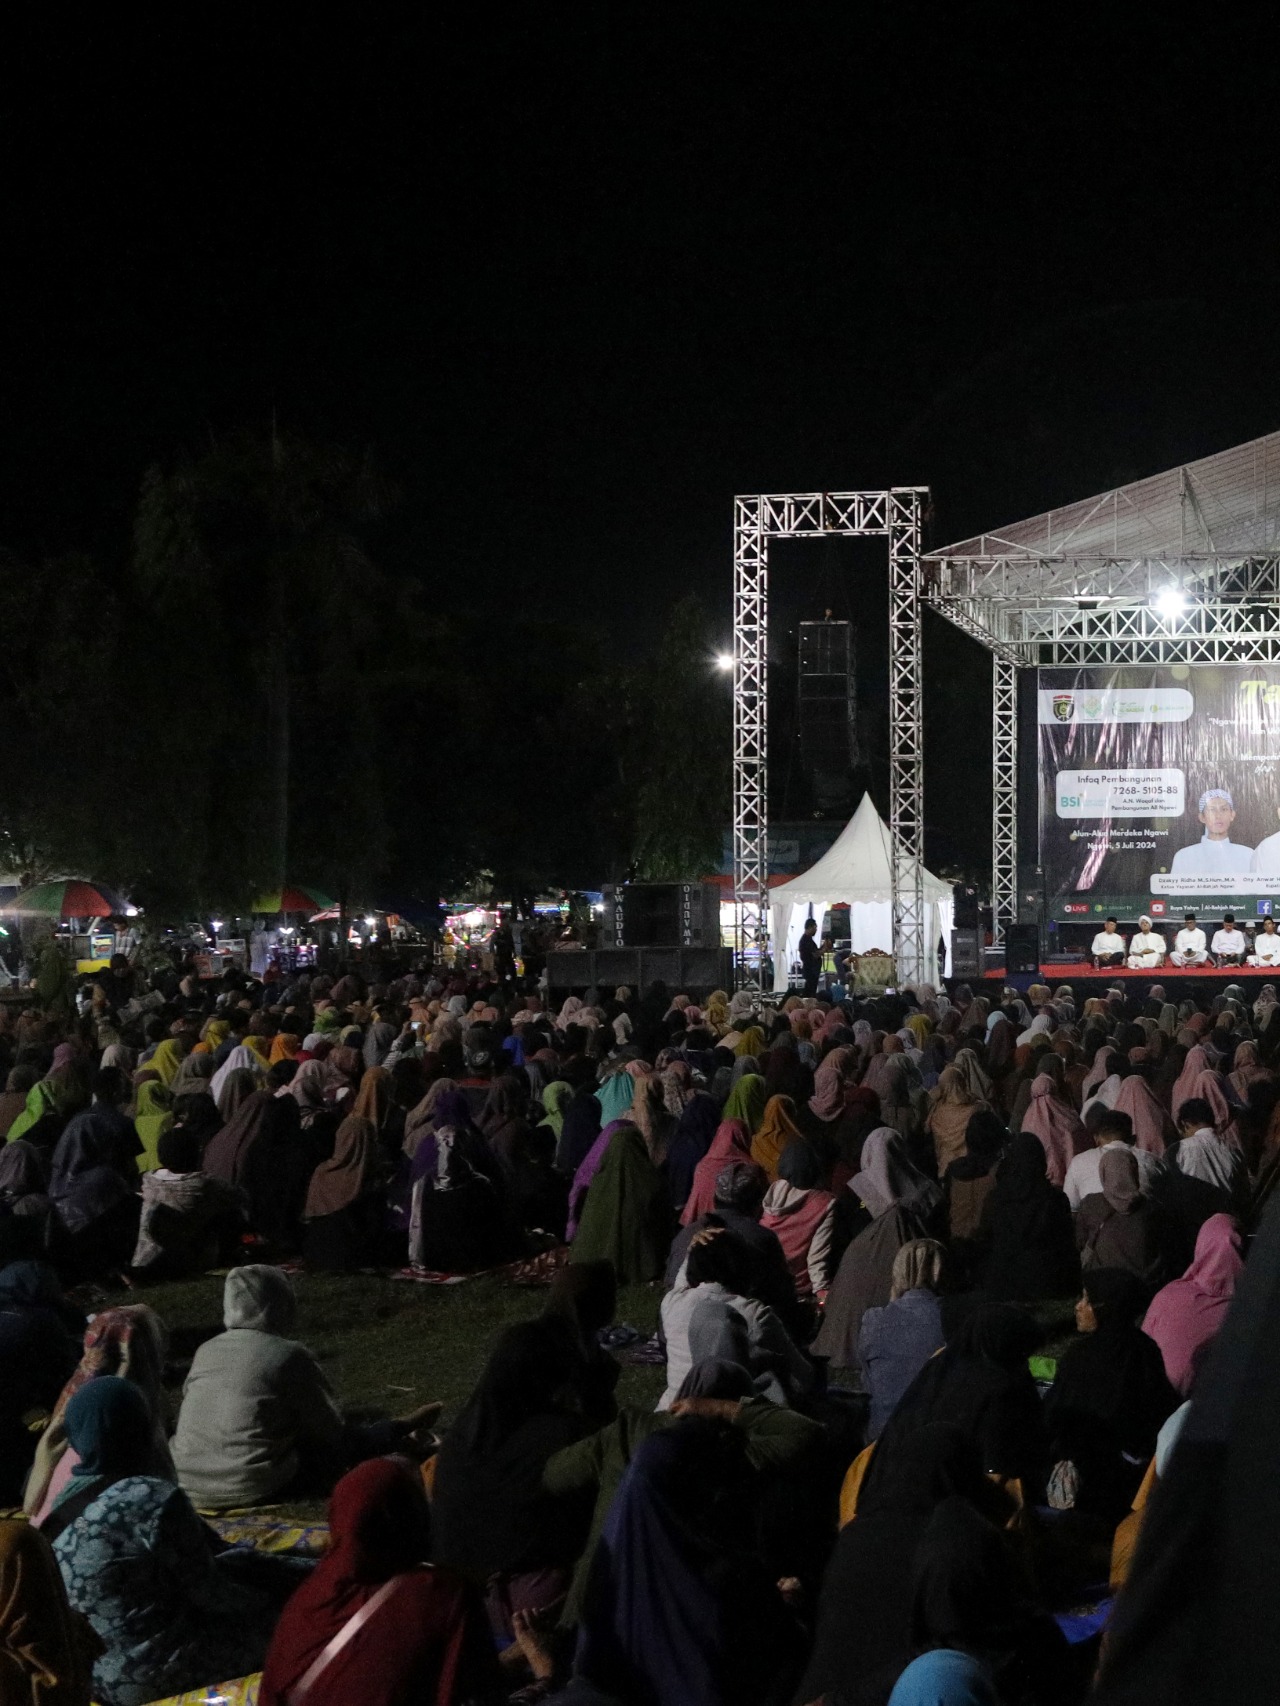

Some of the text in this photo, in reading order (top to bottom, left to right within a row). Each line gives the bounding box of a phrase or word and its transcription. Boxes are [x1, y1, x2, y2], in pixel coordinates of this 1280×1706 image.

[1077, 775, 1162, 785] Infaq Pembangunan
[1060, 796, 1081, 807] BSI
[1110, 828, 1143, 837] Merdeka
[1144, 828, 1169, 837] Ngawi
[1121, 841, 1134, 849] Juli
[1136, 841, 1156, 849] 2024
